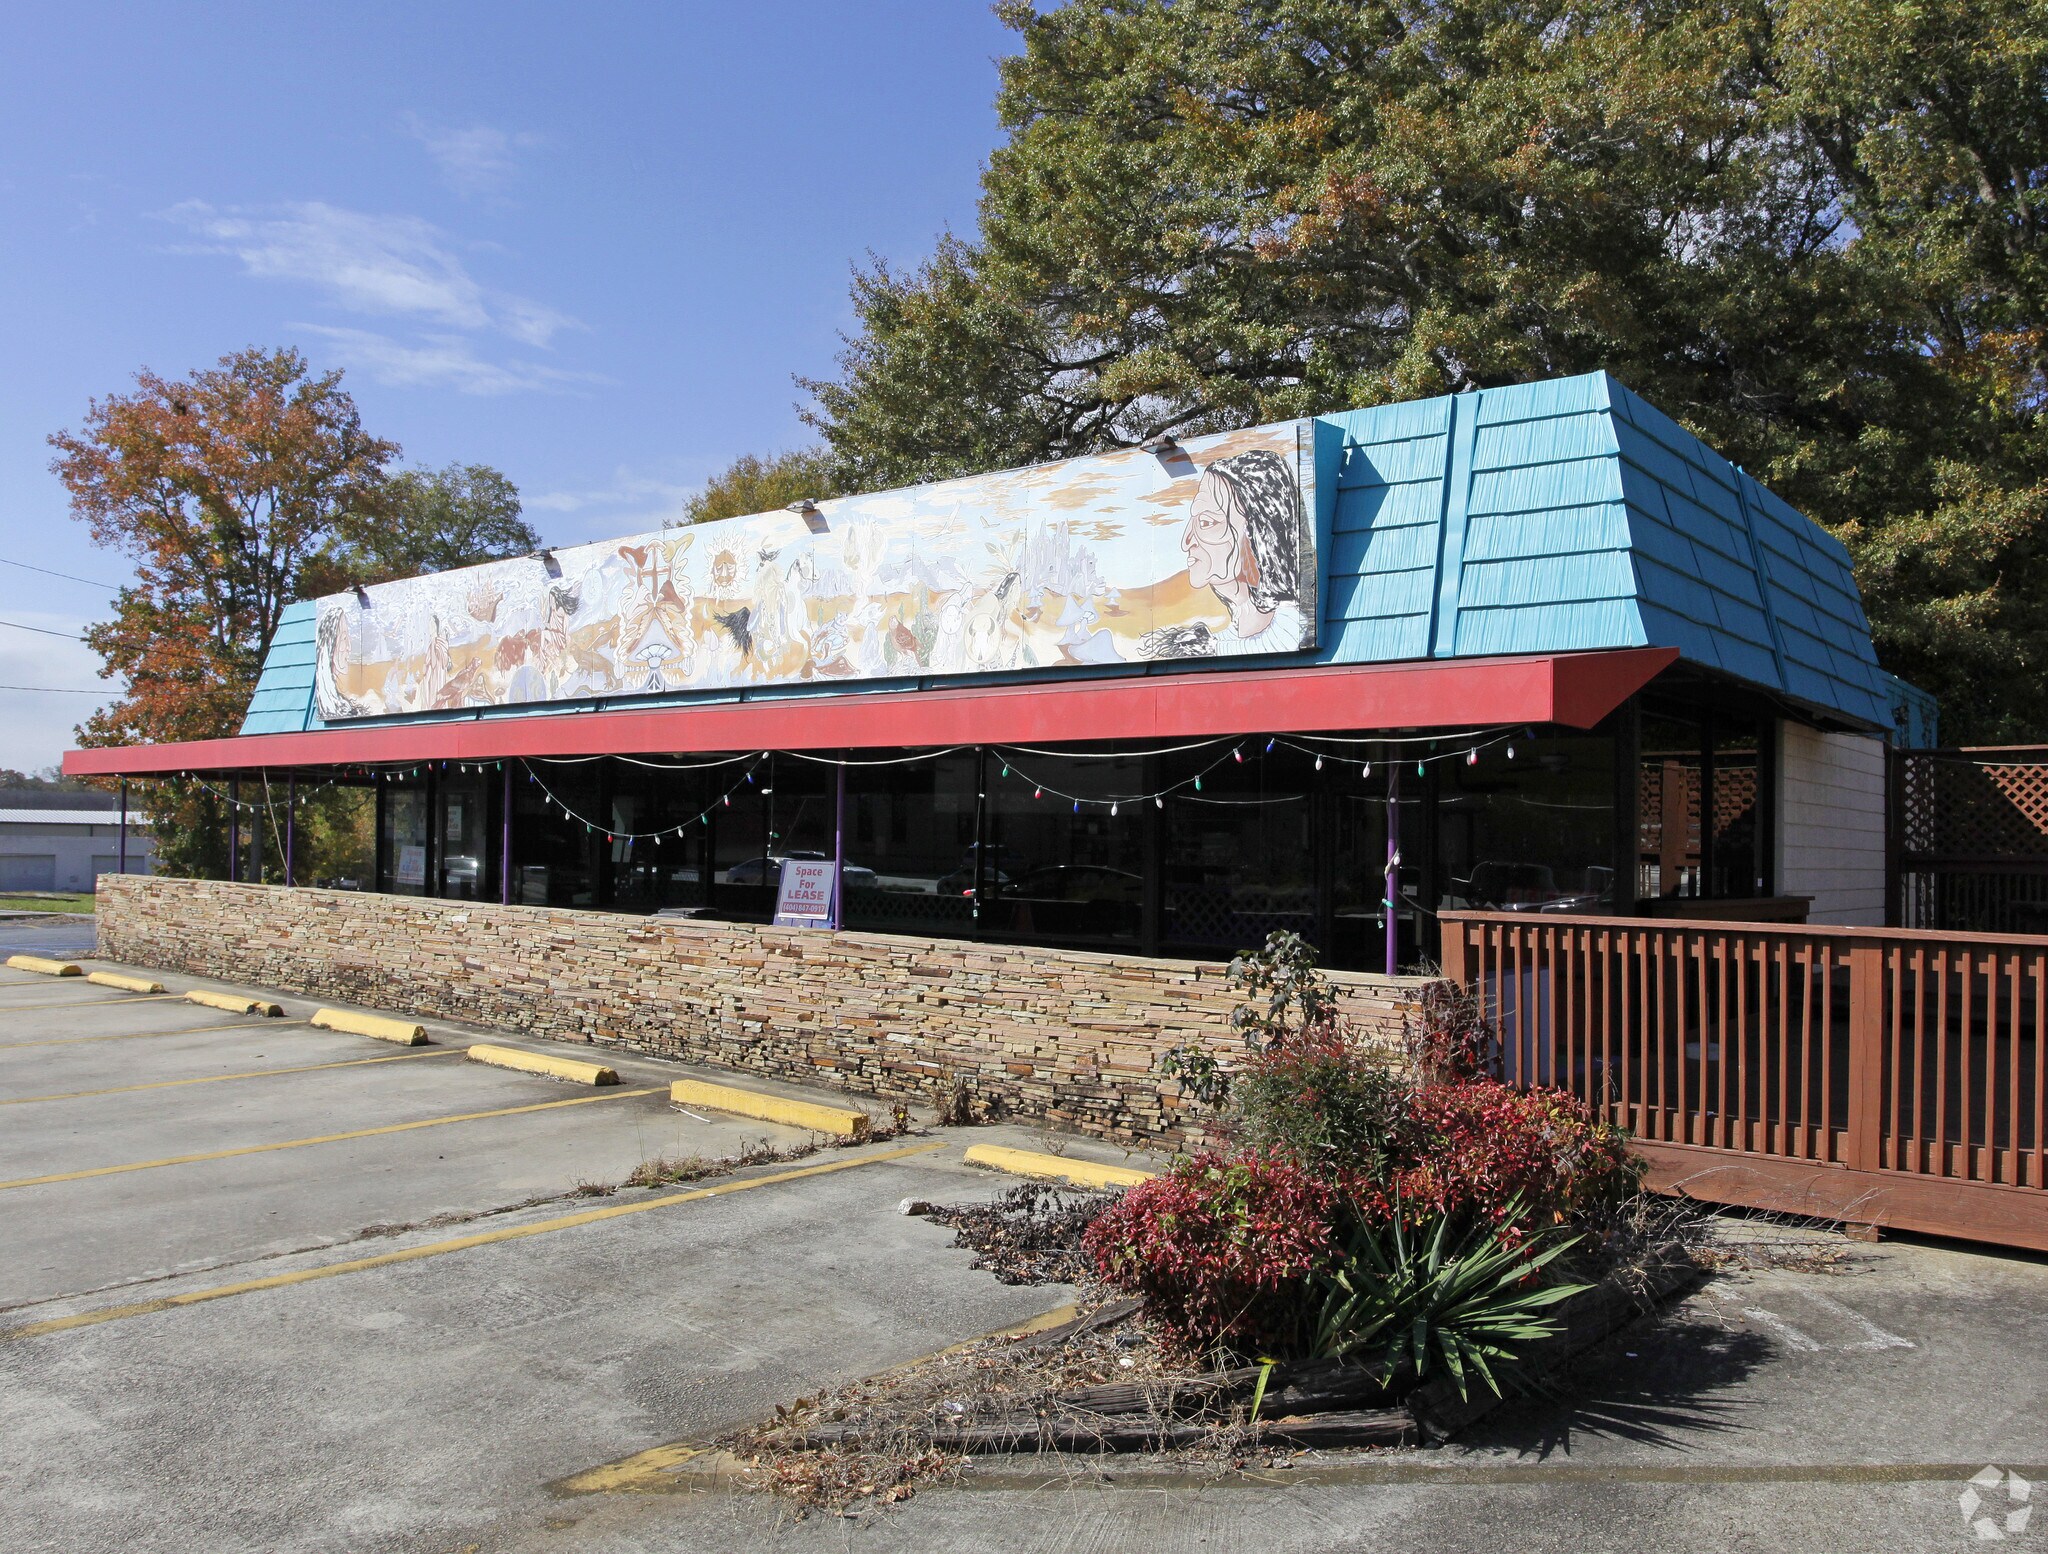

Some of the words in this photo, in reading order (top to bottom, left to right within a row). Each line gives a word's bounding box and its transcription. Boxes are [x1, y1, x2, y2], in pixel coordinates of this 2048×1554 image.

[796, 866, 823, 878] Space
[799, 879, 815, 889] For
[788, 890, 824, 900] LEASE
